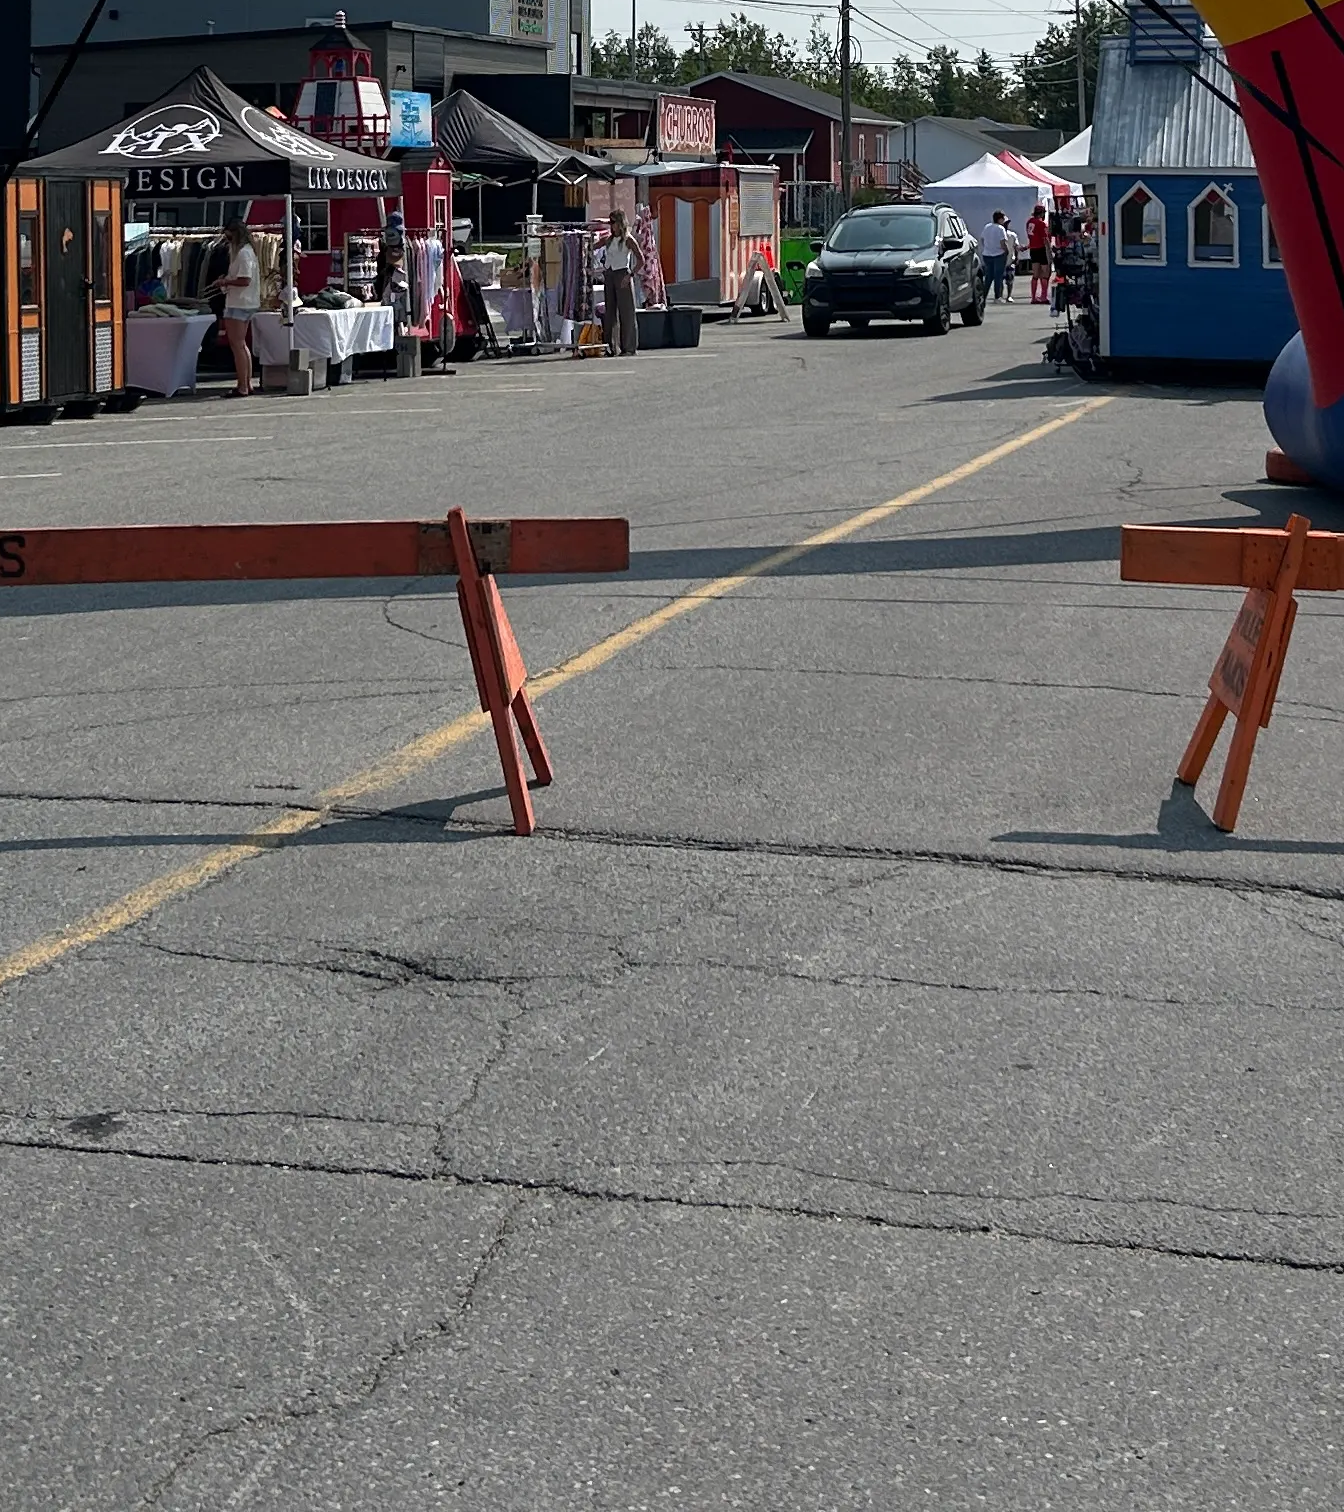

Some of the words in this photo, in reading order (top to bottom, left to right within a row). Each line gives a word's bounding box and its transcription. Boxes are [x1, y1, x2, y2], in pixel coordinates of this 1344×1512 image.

[665, 104, 711, 147] CHURROS
[307, 166, 331, 189] LIX
[337, 168, 388, 190] DESIGN
